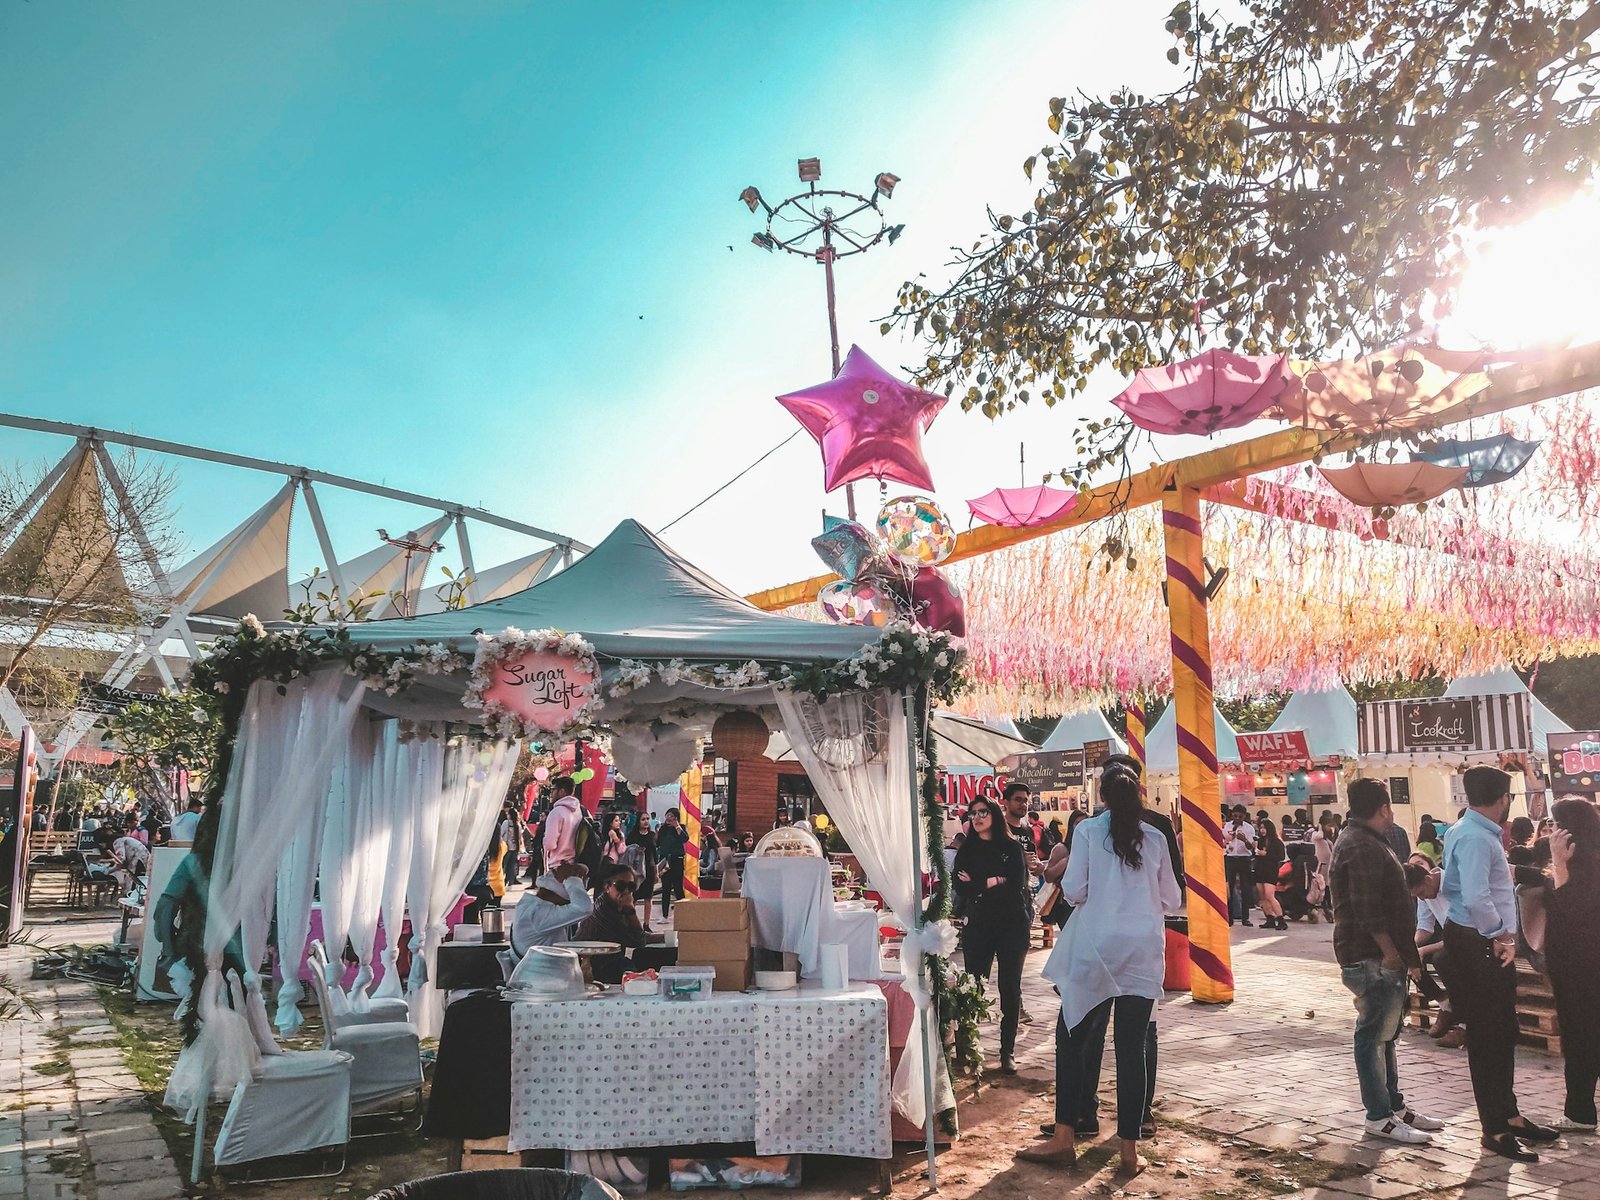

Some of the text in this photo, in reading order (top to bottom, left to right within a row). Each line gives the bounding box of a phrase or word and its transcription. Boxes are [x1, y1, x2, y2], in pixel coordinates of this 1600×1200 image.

[502, 664, 566, 692] Sugar
[532, 680, 584, 710] Loft
[1410, 716, 1465, 740] Icekraft
[1242, 733, 1296, 751] WAFL
[1016, 765, 1054, 778] Chocolate
